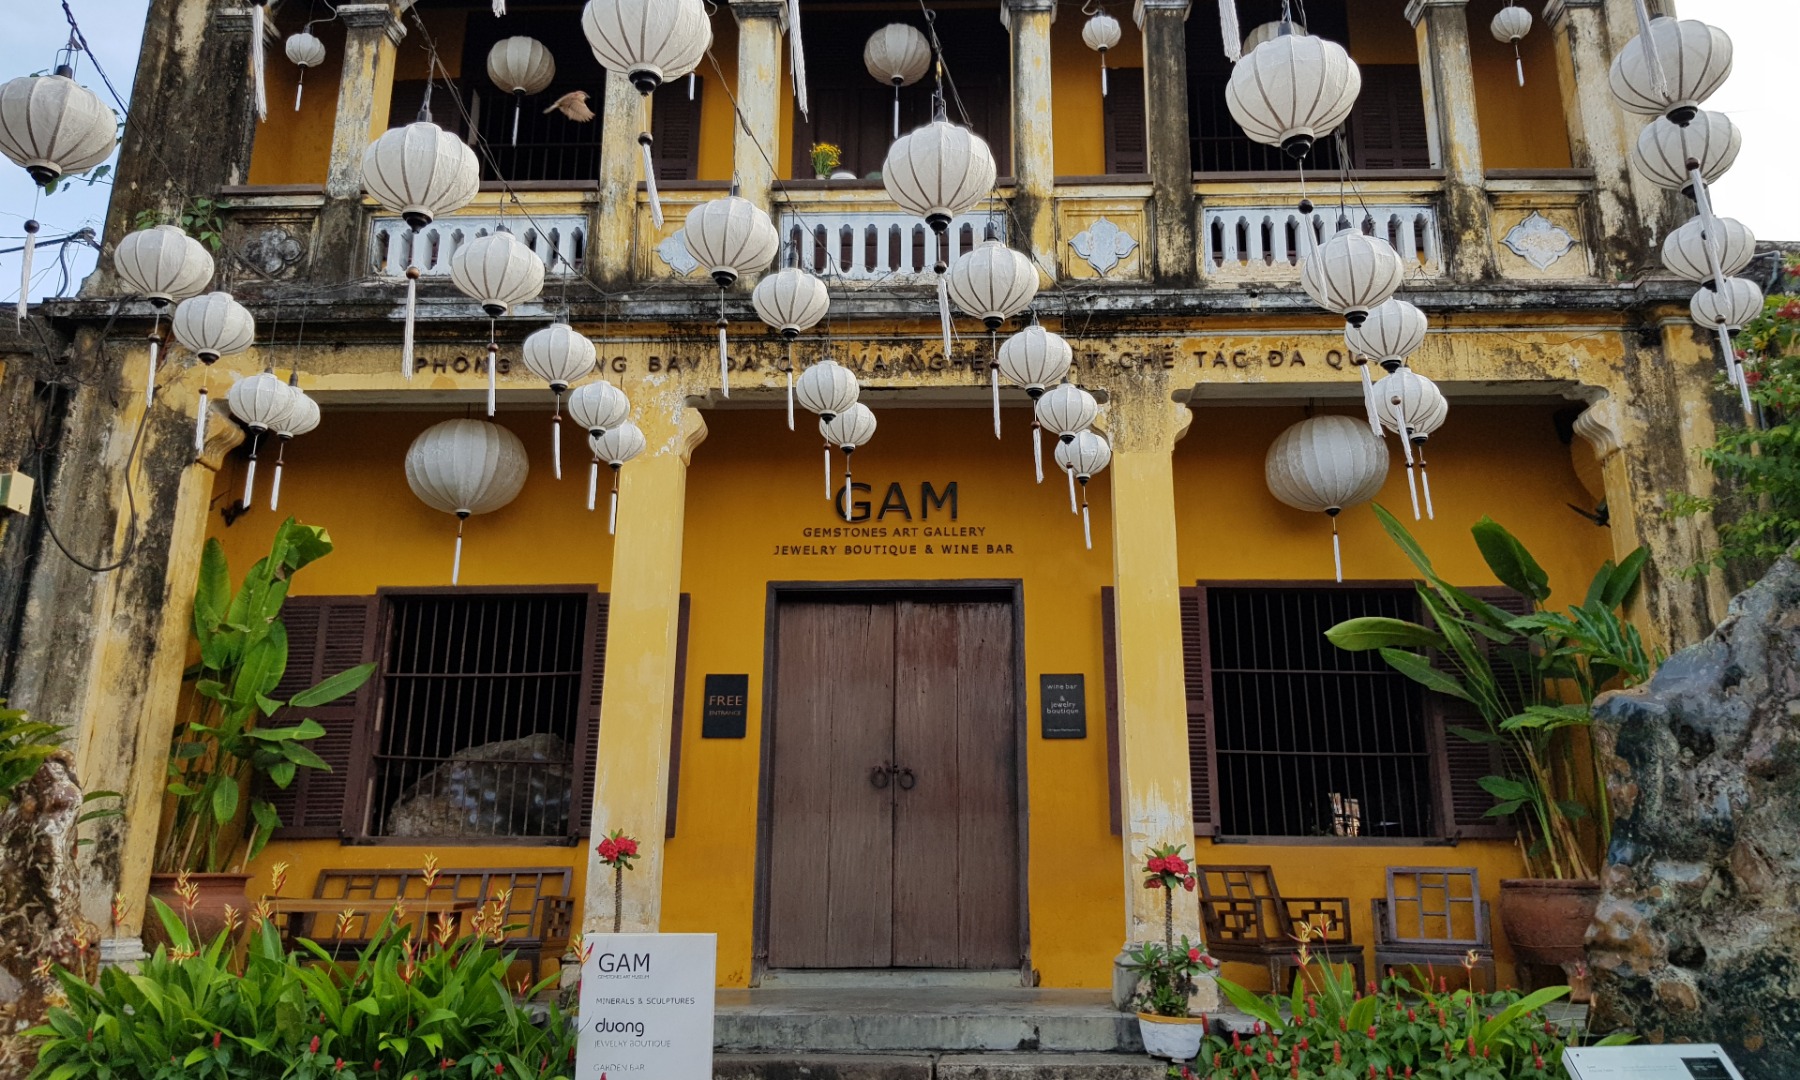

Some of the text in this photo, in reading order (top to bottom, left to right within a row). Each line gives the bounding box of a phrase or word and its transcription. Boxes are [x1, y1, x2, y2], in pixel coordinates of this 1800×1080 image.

[835, 481, 958, 522] GAM
[803, 526, 986, 537] GEMSTONES ART GALLERY
[773, 544, 1015, 555] JEWELRY BOUTIQUE & WINE BAR
[709, 695, 743, 706] FREE
[1050, 701, 1076, 709] jewelry
[598, 953, 650, 973] GAM
[596, 997, 635, 1005] MINERALS
[646, 997, 695, 1005] SCULPTURES
[595, 1018, 645, 1037] duong
